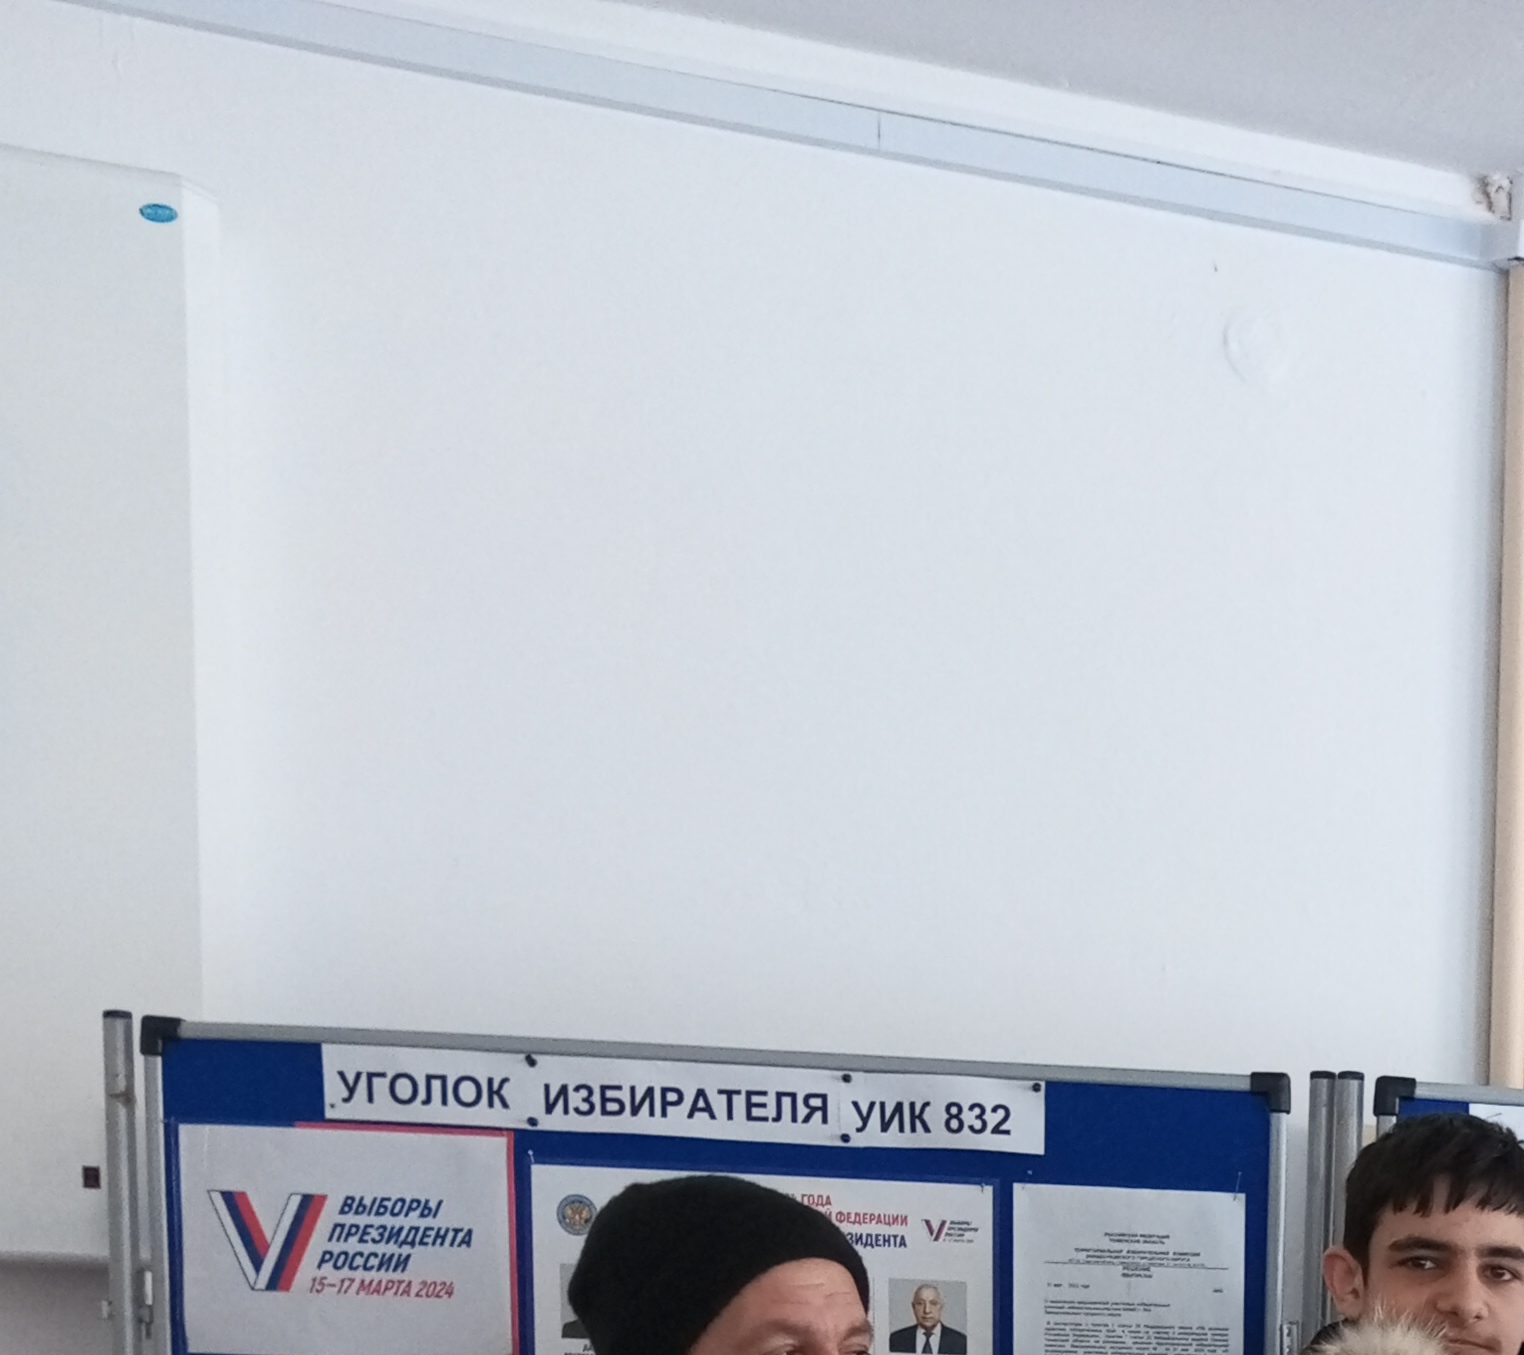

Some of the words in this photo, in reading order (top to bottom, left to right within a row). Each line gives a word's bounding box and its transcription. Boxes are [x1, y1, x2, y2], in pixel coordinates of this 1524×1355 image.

[336, 1070, 511, 1110] УГОЛОК
[543, 1083, 829, 1125] ИЗБИРАТЕЛЯ
[851, 1100, 931, 1134] УИК
[944, 1103, 1012, 1137] 832
[339, 1196, 443, 1219] ВЫБОРЫ
[801, 1194, 832, 1207] ГОДА
[835, 1211, 908, 1227] ФЕДЕРАЦИИ
[328, 1223, 474, 1249] ПРЕЗИДЕНТА
[845, 1232, 908, 1248] ЗИДЕНТА
[317, 1250, 412, 1273] РОССИИ
[356, 1279, 412, 1297] МАРТА
[415, 1280, 455, 1299] 2024
